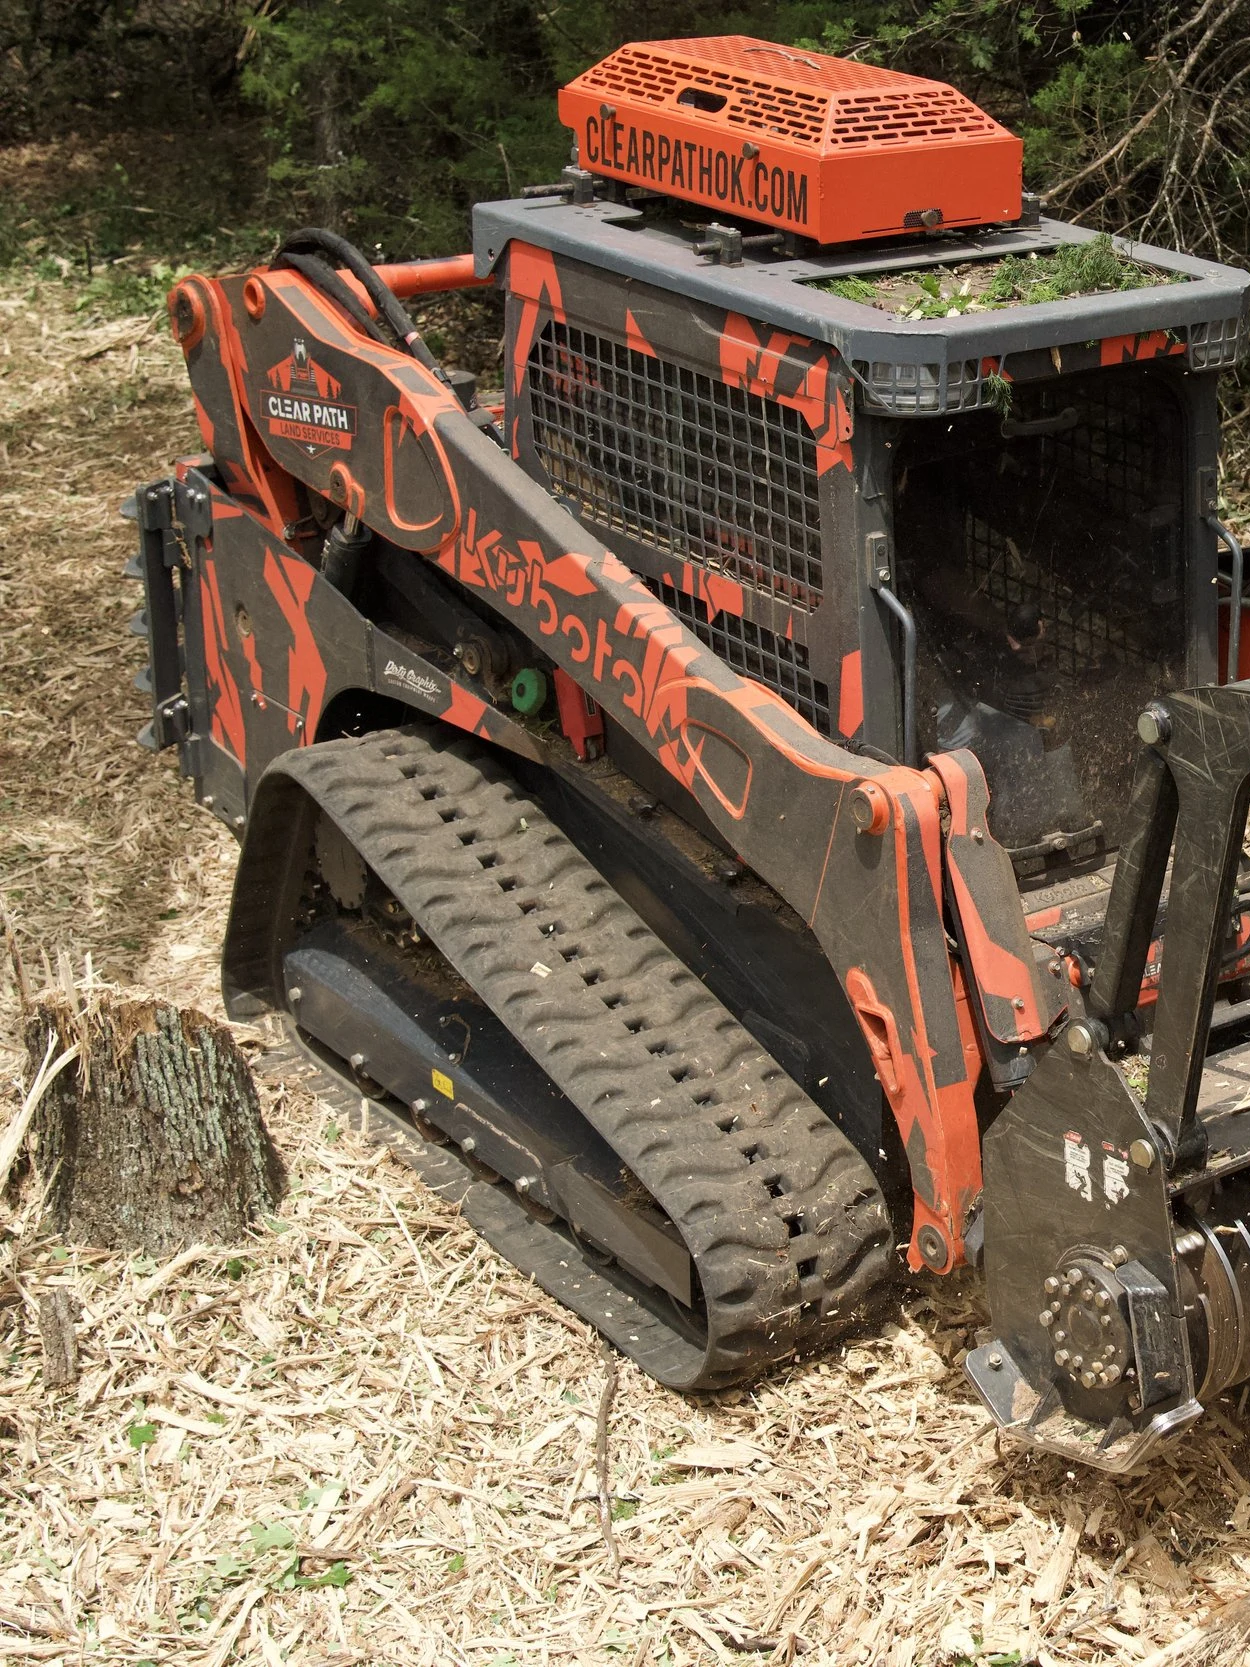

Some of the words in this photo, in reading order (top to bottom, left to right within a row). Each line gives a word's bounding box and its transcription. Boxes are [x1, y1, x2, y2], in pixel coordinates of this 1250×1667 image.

[586, 115, 808, 225] CLEARPATHOK.COM
[268, 396, 311, 422] CLEAR
[313, 404, 348, 429] PATH
[280, 422, 302, 438] LAND
[302, 429, 340, 446] SERVICES
